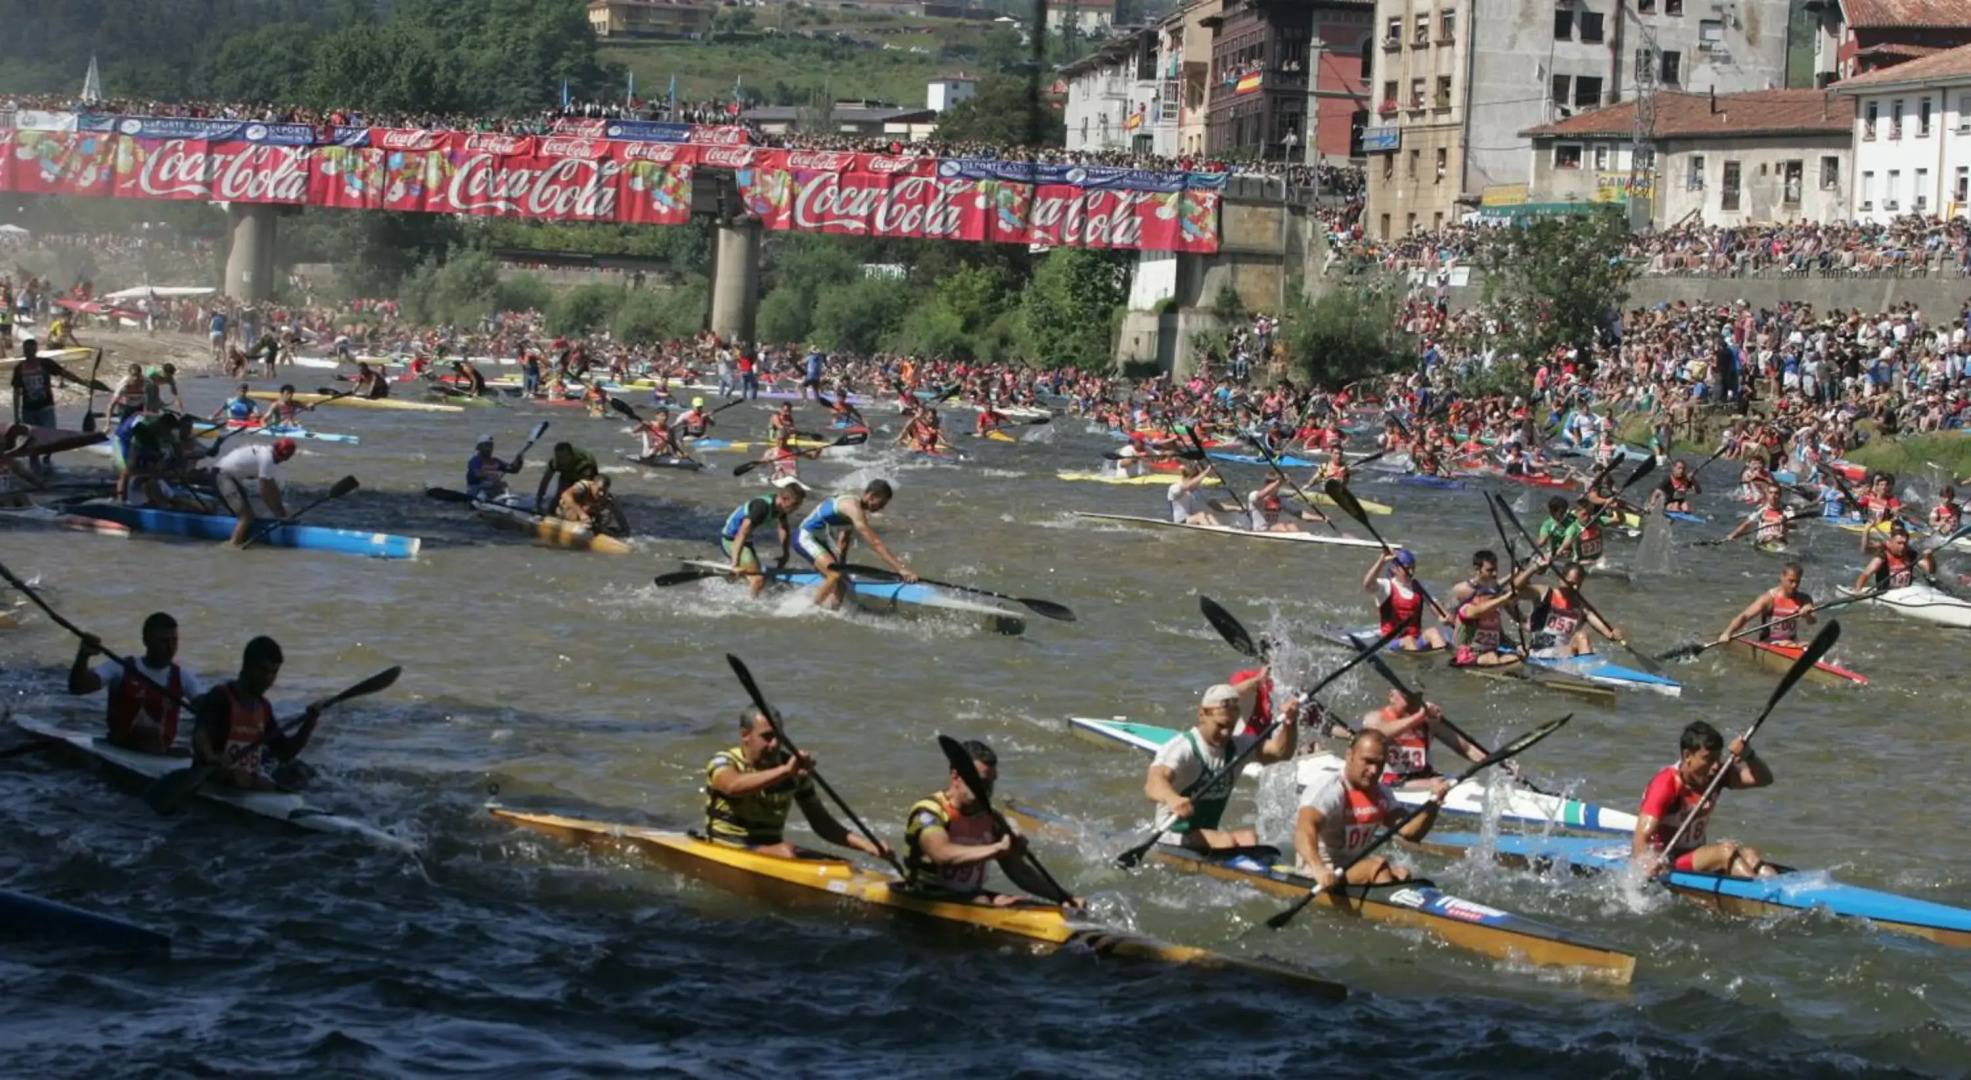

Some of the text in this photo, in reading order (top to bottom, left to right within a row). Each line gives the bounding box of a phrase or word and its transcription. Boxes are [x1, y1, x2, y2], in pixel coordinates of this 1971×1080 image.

[543, 138, 592, 158] Coca-Cola
[787, 152, 839, 170] Coca-Cola
[140, 139, 311, 200] Coca-Cola
[448, 153, 622, 217] Coca-Cola
[795, 171, 970, 235] Coca-Cola
[1547, 613, 1575, 634] 053
